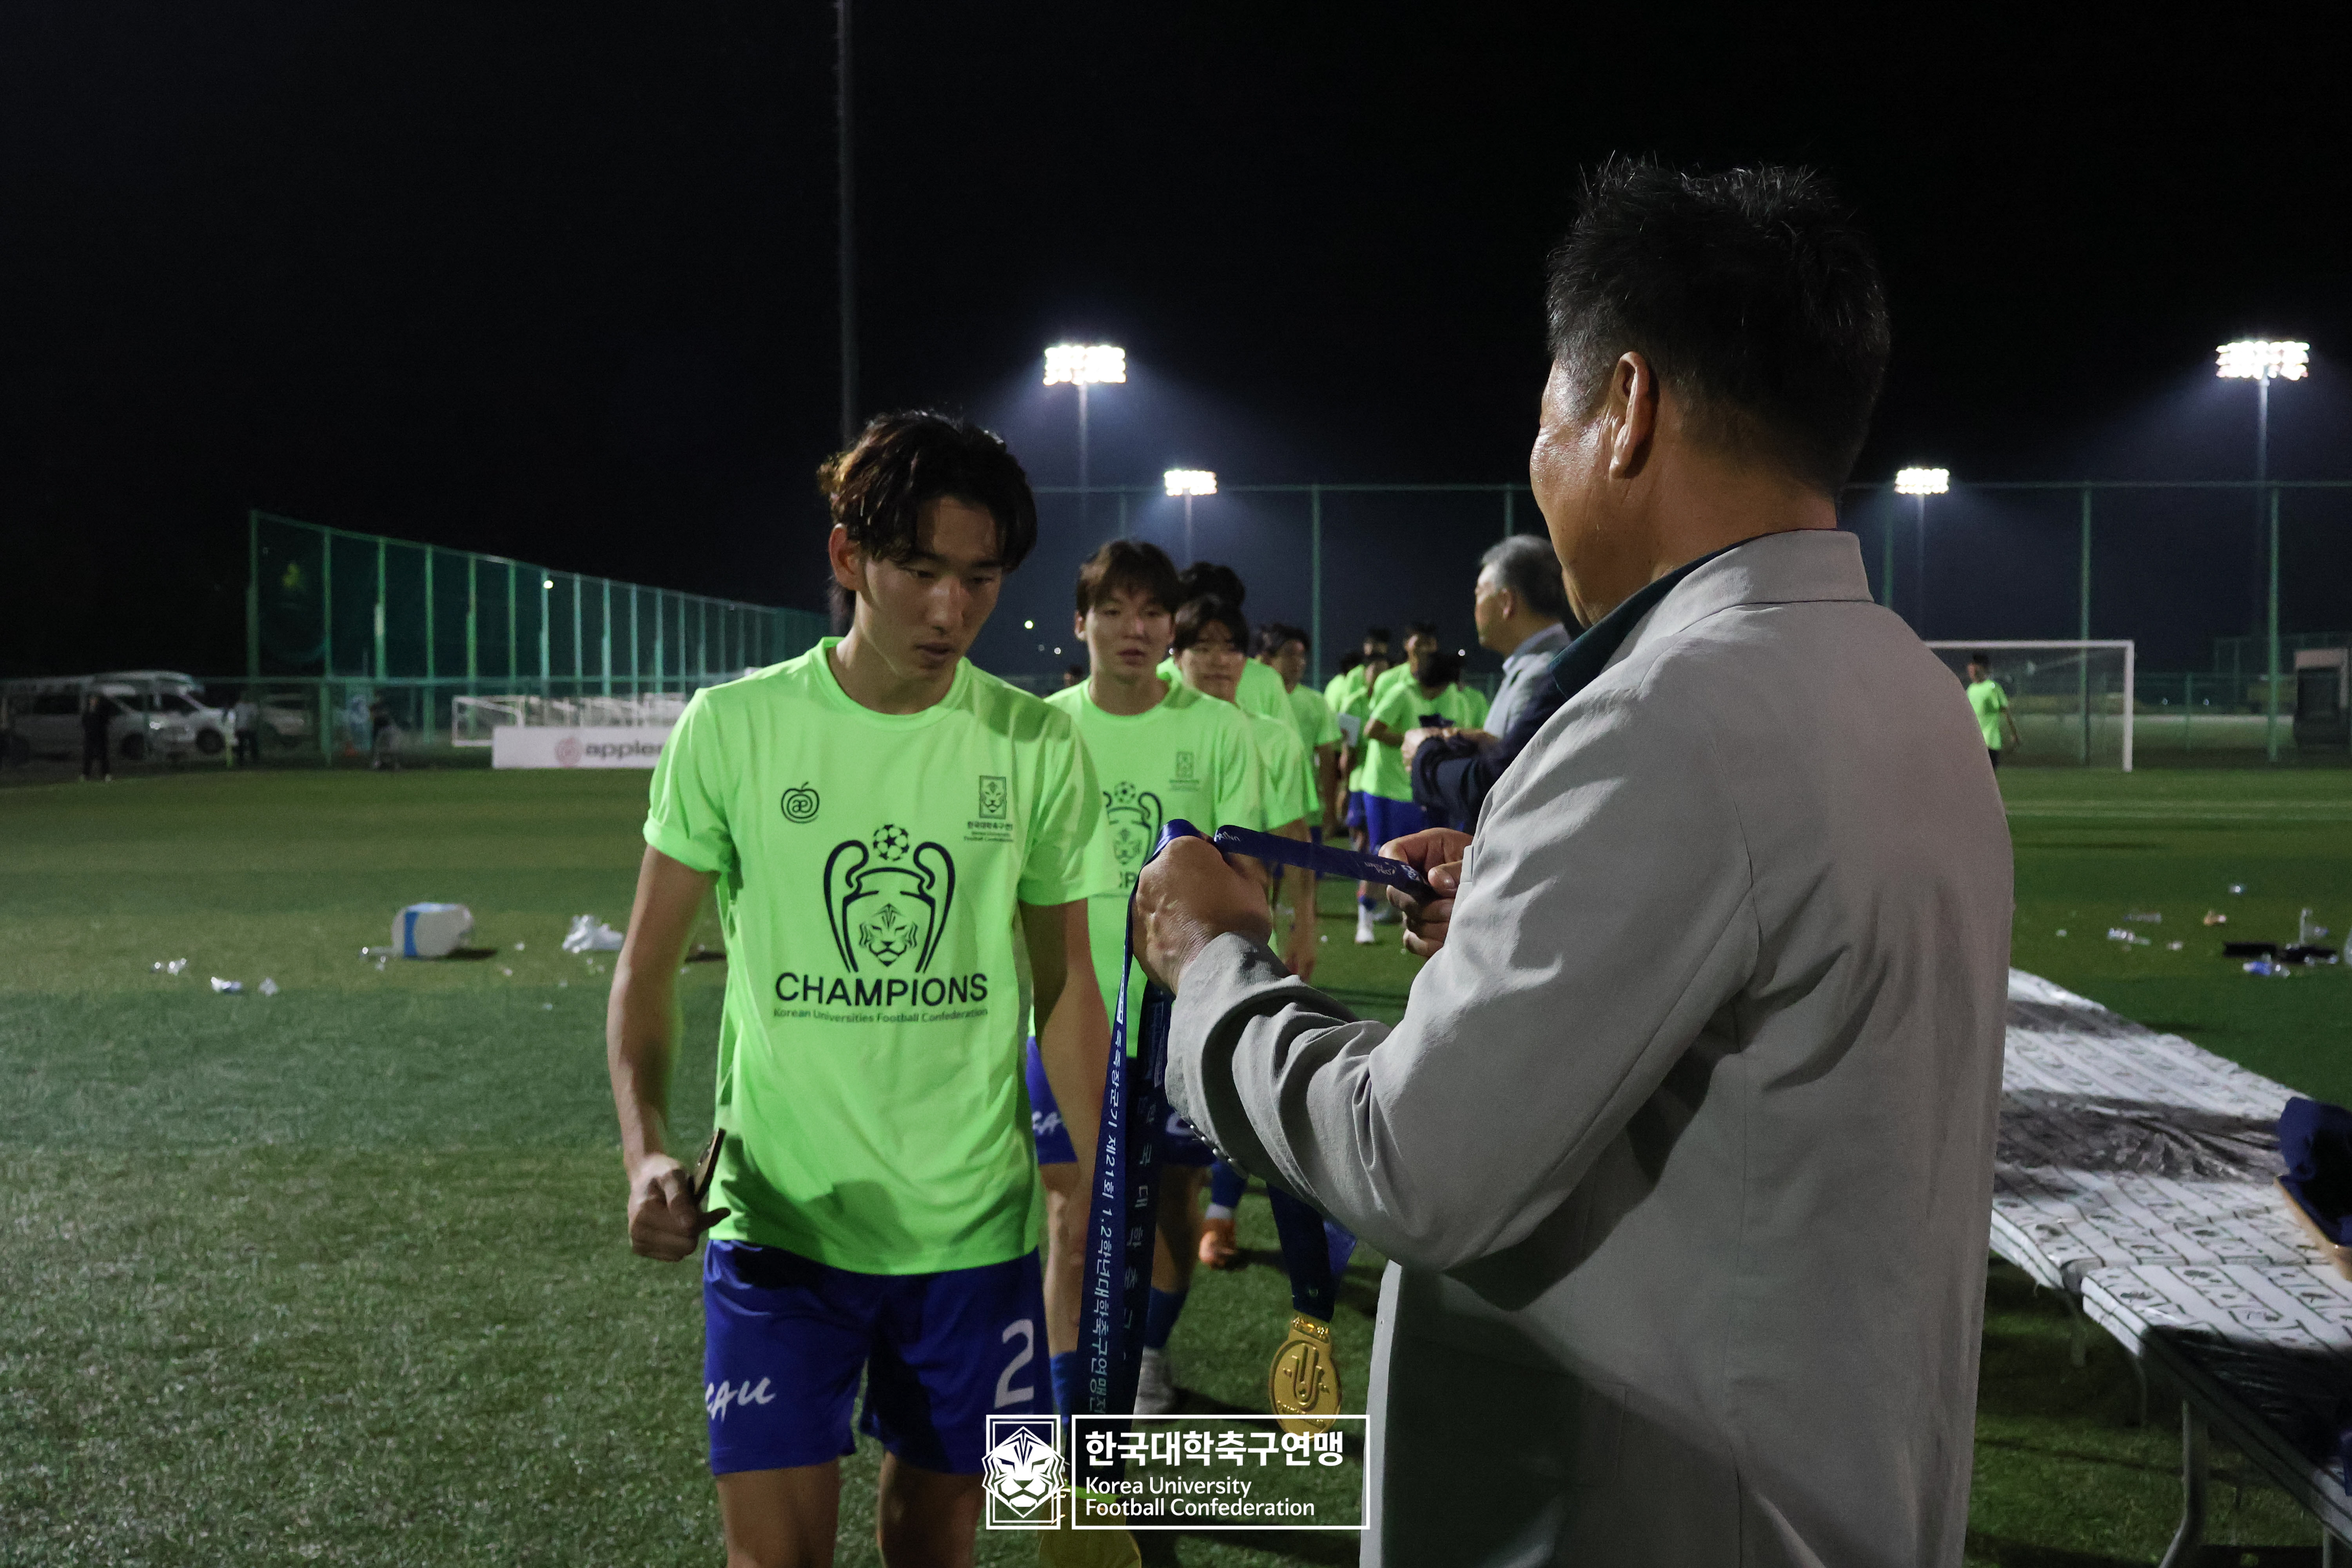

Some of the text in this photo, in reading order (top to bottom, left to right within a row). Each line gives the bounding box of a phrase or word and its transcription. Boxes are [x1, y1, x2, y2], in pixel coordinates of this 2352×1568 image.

[775, 973, 987, 1006] CHAMPIONS
[774, 1008, 987, 1022] Korean Universities Football Confederation
[1102, 1134, 1116, 1199] 제21회
[994, 1318, 1034, 1410] 2
